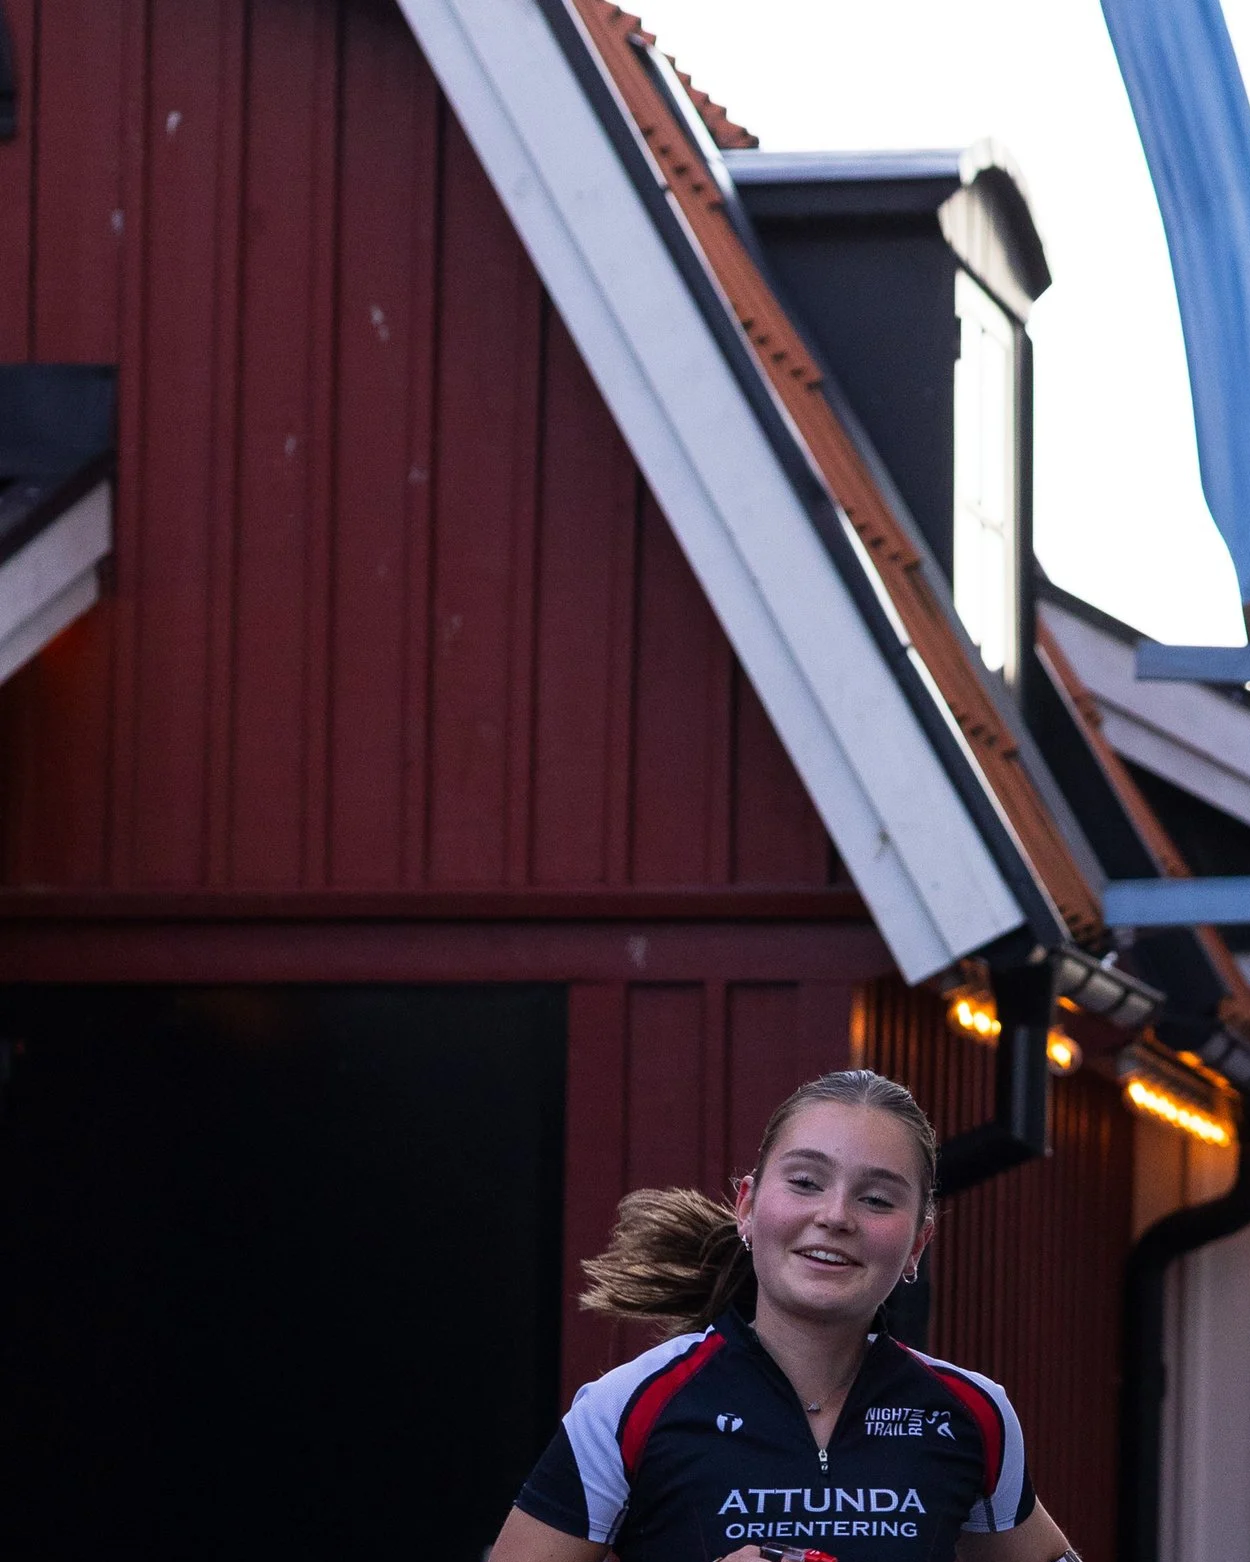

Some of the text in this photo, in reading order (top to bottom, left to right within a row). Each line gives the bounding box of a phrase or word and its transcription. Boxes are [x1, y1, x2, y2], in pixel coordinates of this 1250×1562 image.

[865, 1407, 912, 1421] NIGHT
[908, 1409, 925, 1436] RUN
[865, 1422, 908, 1436] TRAIL
[717, 1487, 927, 1514] ATTUNDA
[725, 1520, 918, 1539] ORIENTERING
